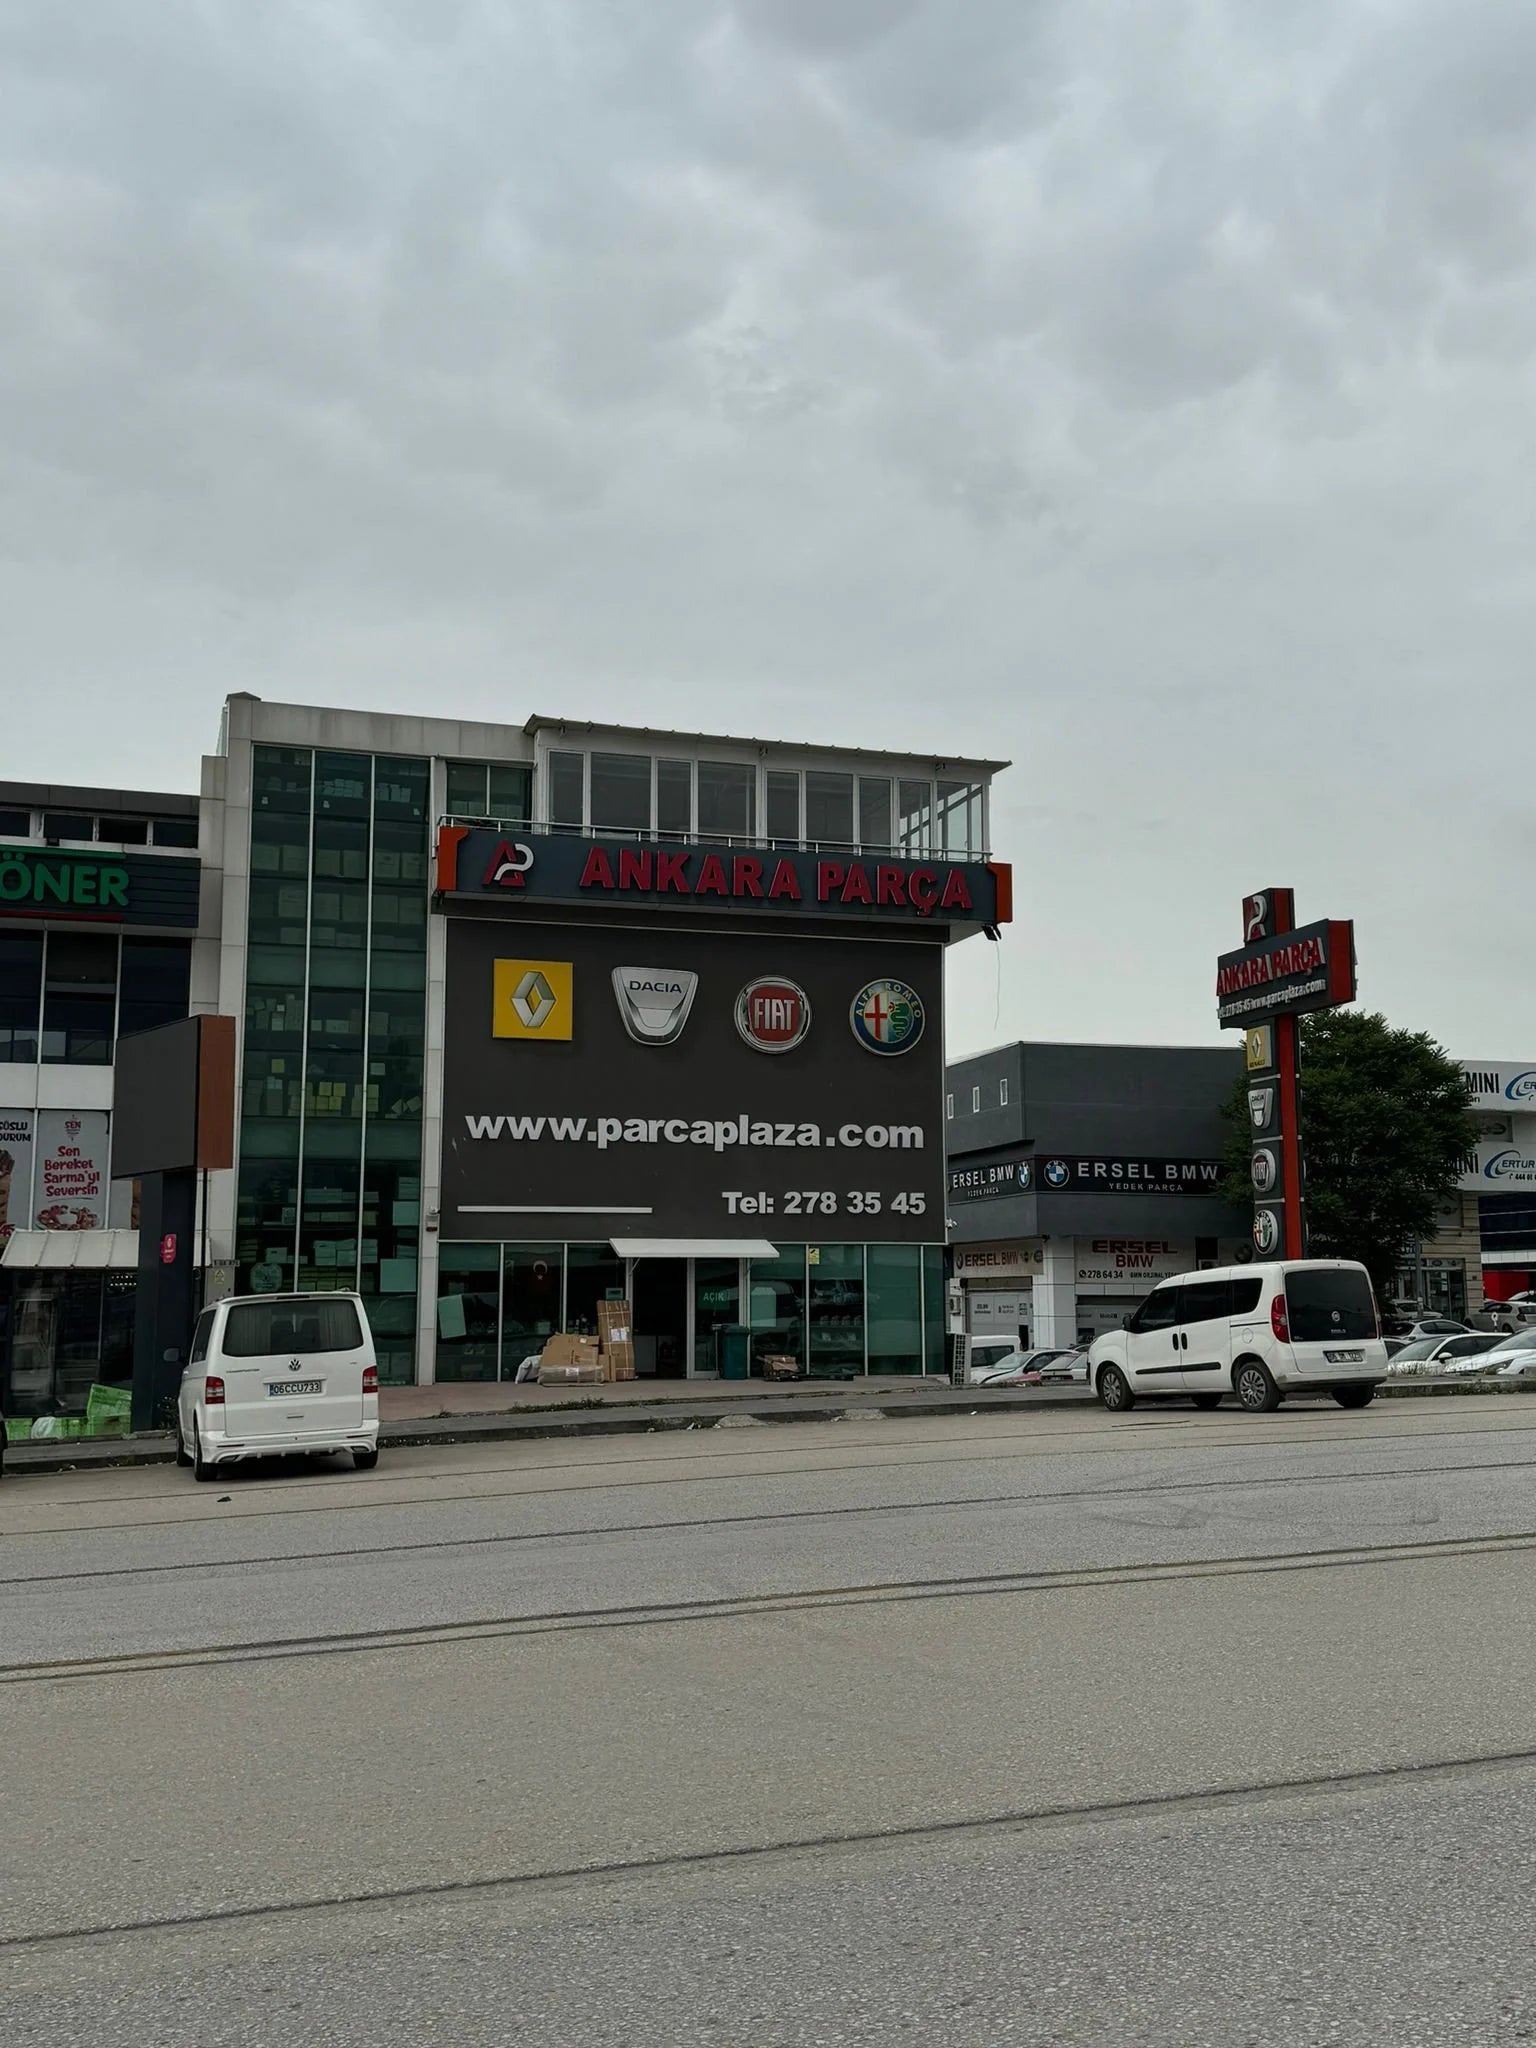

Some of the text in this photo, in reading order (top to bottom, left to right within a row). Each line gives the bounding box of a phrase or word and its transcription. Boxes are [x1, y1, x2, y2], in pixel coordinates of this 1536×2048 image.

[579, 847, 974, 917] ANKARA PARÇA
[1216, 937, 1326, 997] ANKARA PARÇA
[629, 980, 682, 994] DACIA
[855, 981, 922, 1019] ALFA ROMEO
[754, 998, 796, 1031] FIAT
[1465, 1072, 1500, 1094] MINI
[465, 1114, 926, 1152] www.parcaplaza.com
[58, 1146, 81, 1157] Sen
[44, 1159, 94, 1171] Bereket
[1077, 1162, 1218, 1180] ERSEL BMW
[952, 1170, 986, 1189] ERSEL
[989, 1164, 1015, 1183] BMW
[46, 1184, 99, 1197] Seversin
[1109, 1183, 1144, 1191] YEDEK
[722, 1192, 927, 1215] Tel: 278 35 45
[1092, 1239, 1178, 1254] ERSEL
[964, 1252, 1000, 1267] ERSEL
[1115, 1254, 1154, 1268] BMW
[1087, 1270, 1123, 1278] 278 64 34
[703, 1291, 726, 1304] AÇIK
[273, 1382, 320, 1394] 06CCU733
